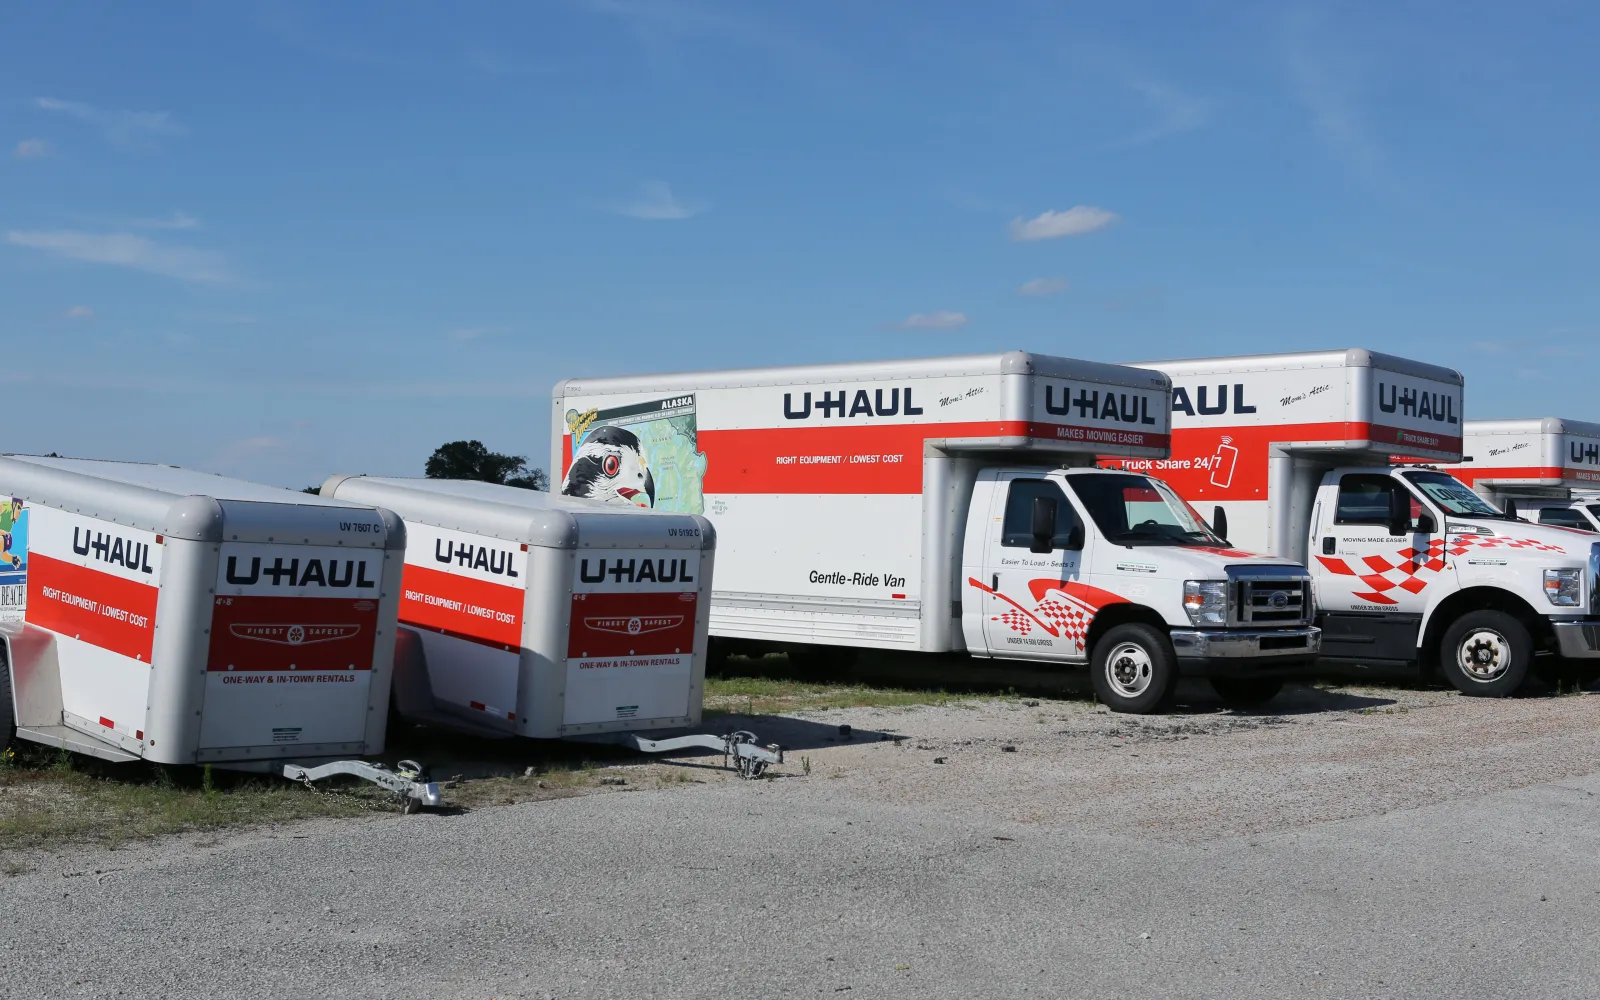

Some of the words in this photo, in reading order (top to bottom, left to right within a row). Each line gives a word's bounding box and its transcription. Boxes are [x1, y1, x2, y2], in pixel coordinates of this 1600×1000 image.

[661, 396, 693, 410] ALASKA
[783, 387, 923, 420] U-HAUL
[939, 394, 963, 407] Mom's
[965, 386, 985, 398] Attic
[1045, 385, 1155, 425] U-HAUL
[1280, 393, 1306, 407] Mom's
[1308, 384, 1329, 397] Attic
[1379, 382, 1457, 424] U-HAUL
[1057, 427, 1084, 439] MAKES
[1086, 430, 1117, 442] MOVING
[1118, 434, 1144, 445] EASIER
[1403, 433, 1417, 443] TRUCK
[776, 456, 797, 465] RIGHT
[799, 455, 842, 464] EQUIPMENT
[849, 454, 880, 463] LOWEST
[882, 454, 904, 463] COST
[1489, 446, 1510, 456] Mom's
[1571, 441, 1600, 466] U-H
[1120, 459, 1153, 470] Truck
[1193, 455, 1222, 471] 24/7
[339, 522, 351, 531] UV
[354, 522, 371, 532] 7607
[374, 524, 380, 533] C
[668, 528, 677, 536] UV
[678, 528, 693, 536] 5192
[694, 528, 699, 536] C
[73, 526, 153, 574] U-HAUL
[435, 538, 518, 578] U-HAUL
[580, 559, 694, 583] U-HAUL
[1001, 558, 1020, 566] Easier
[226, 556, 375, 588] U-HAUL
[809, 570, 879, 587] Gentle-Ride
[883, 573, 906, 587] Van
[1, 585, 23, 606] BEACH
[42, 586, 61, 600] RIGHT
[61, 592, 98, 613] EQUIPMENT
[102, 604, 129, 622] LOWEST
[405, 590, 424, 602] RIGHT
[425, 594, 462, 612] EQUIPMENT
[467, 604, 495, 619] LOWEST
[1006, 637, 1023, 645] UNDER
[1037, 639, 1053, 647] GROSS
[579, 660, 612, 670] ONE-WAY
[613, 660, 619, 668] &
[620, 659, 650, 668] IN-TOWN
[650, 658, 680, 666] RENTALS
[223, 675, 266, 684] ONE-WAY
[267, 675, 274, 684] &
[276, 675, 315, 684] IN-TOWN
[316, 675, 355, 683] RENTALS
